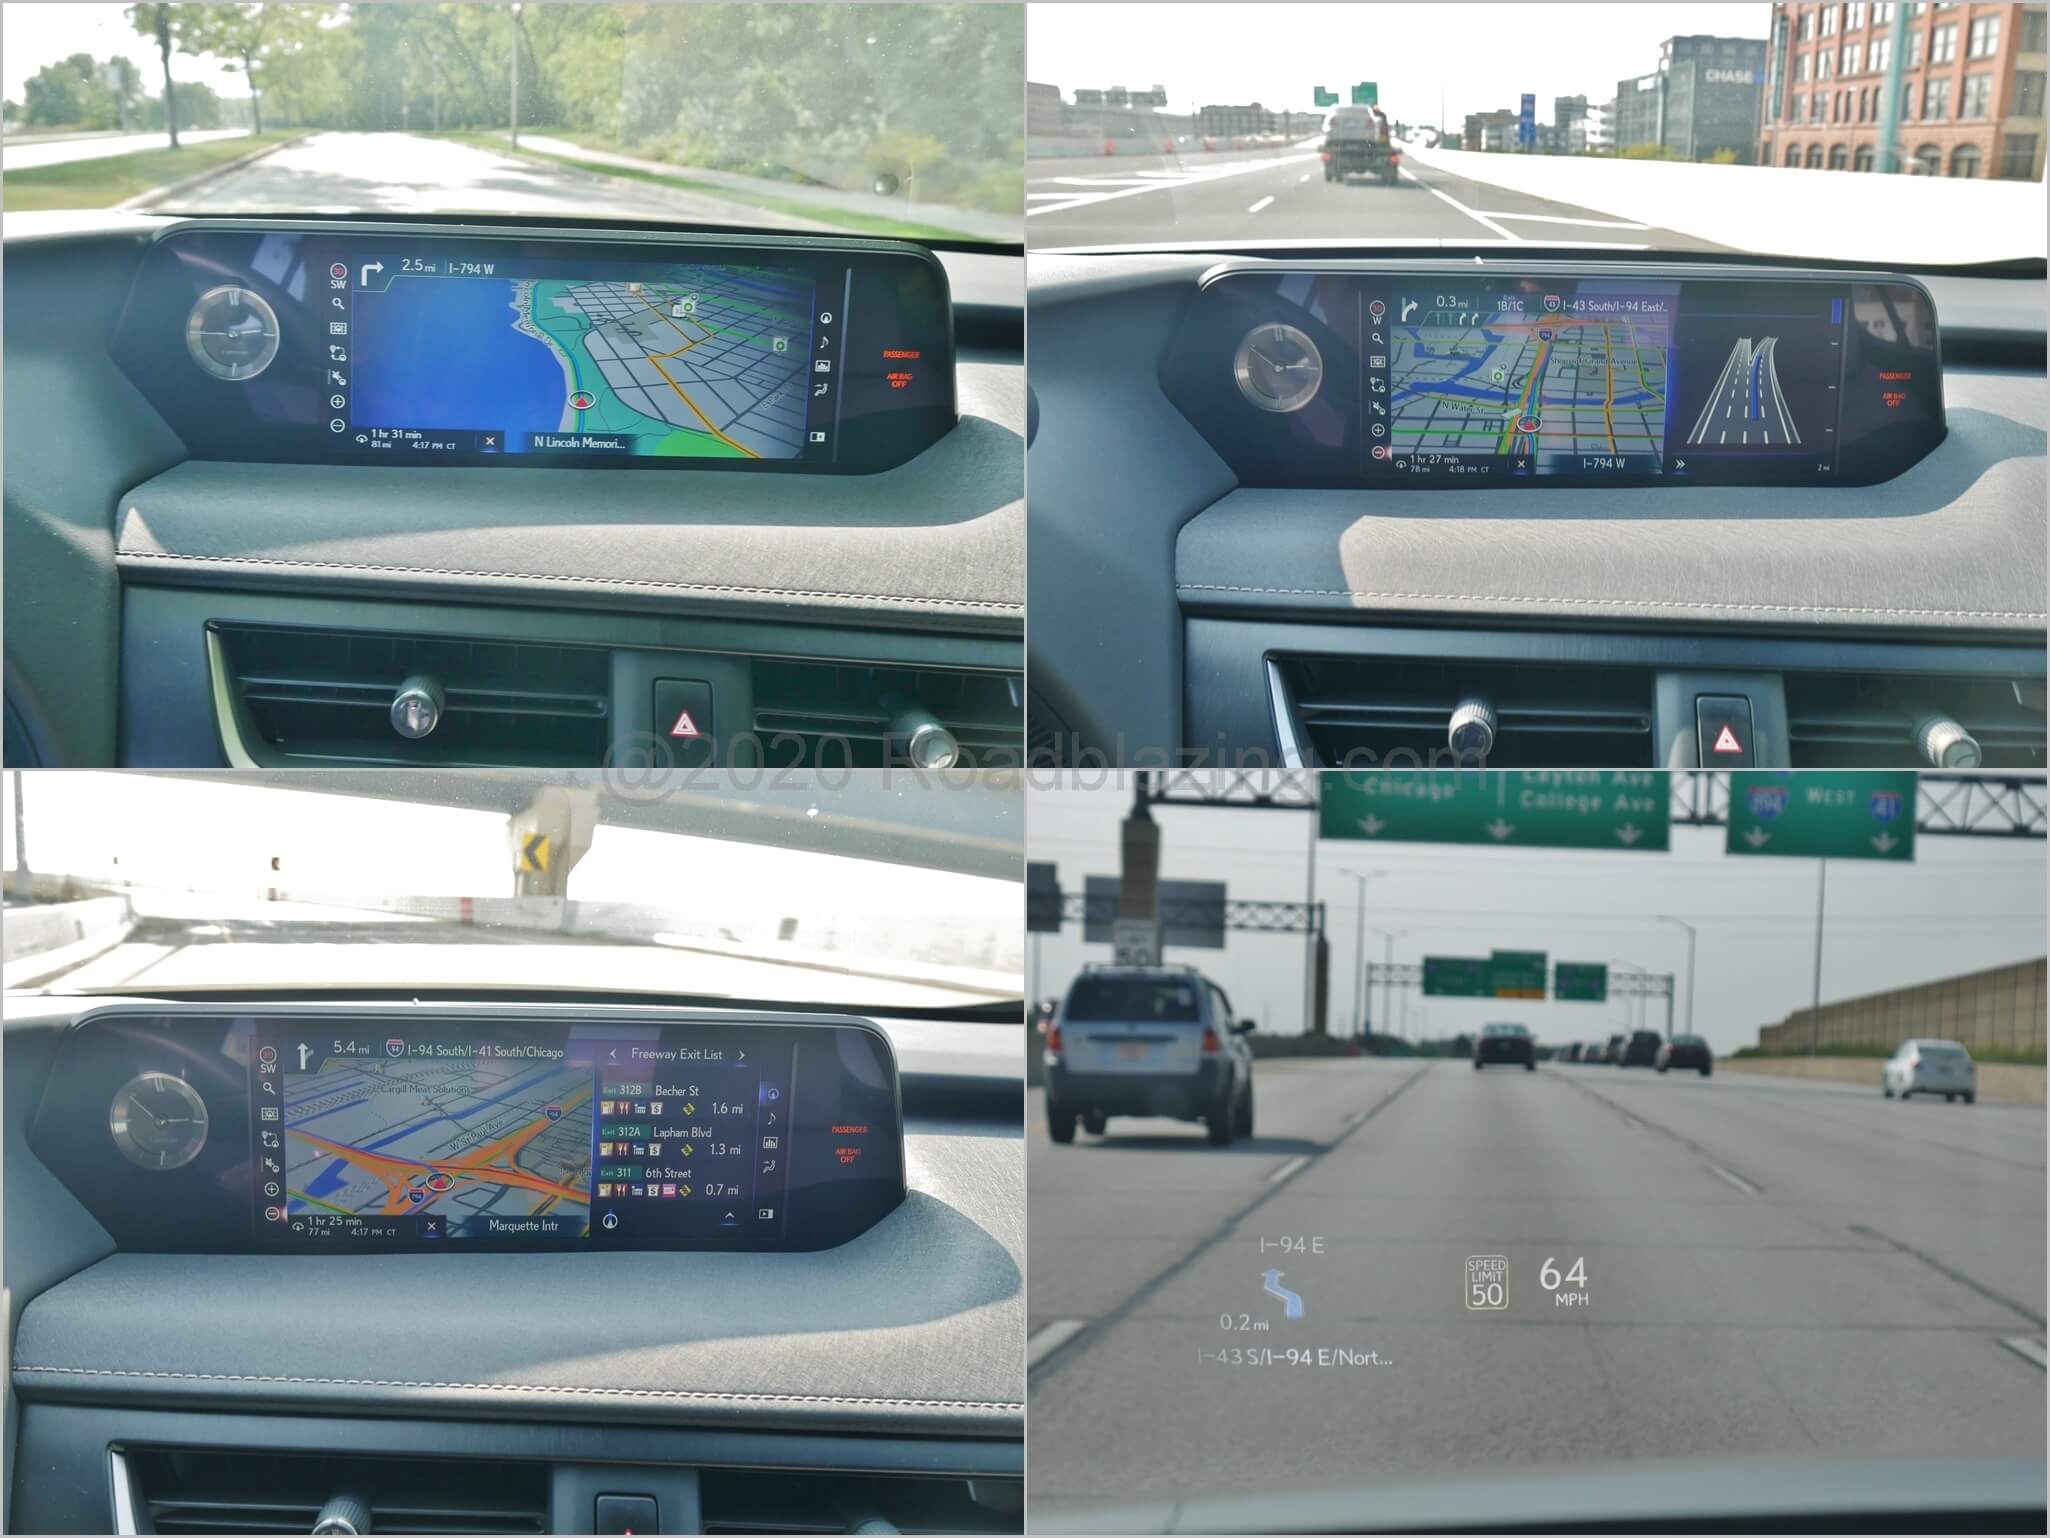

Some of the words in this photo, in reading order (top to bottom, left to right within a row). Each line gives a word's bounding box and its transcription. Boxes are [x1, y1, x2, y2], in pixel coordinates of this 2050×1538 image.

[1705, 68, 1754, 84] CHASE
[402, 258, 424, 272] 2.5
[424, 263, 437, 273] mi
[449, 263, 481, 274] I-794
[483, 263, 495, 275] W
[330, 280, 347, 289] SW
[1436, 295, 1457, 308] 0.3
[1458, 299, 1469, 309] mi
[1497, 300, 1525, 312] 1B/1C
[1563, 299, 1586, 311] I-43
[1373, 317, 1382, 325] W
[372, 429, 377, 438] 1
[379, 429, 389, 438] hr
[391, 429, 403, 439] 31
[405, 430, 422, 439] min
[371, 440, 381, 448] 81
[412, 441, 430, 449] 4:17
[534, 436, 544, 447] N
[546, 436, 580, 448] Lincoln
[1410, 454, 1415, 464] 1
[1418, 455, 1426, 464] hr
[1429, 454, 1442, 464] 27
[1444, 456, 1460, 464] min
[1583, 457, 1613, 469] I-794
[1615, 457, 1626, 469] W
[1449, 465, 1465, 473] 4:18
[1520, 789, 1602, 815] College
[1614, 794, 1656, 812] Ave
[334, 1040, 356, 1053] 5.4
[358, 1044, 370, 1055] mi
[408, 1044, 433, 1056] I-94
[436, 1044, 491, 1057] South/I-41
[495, 1045, 564, 1060] South/Chicago
[631, 1047, 677, 1061] Freeway
[680, 1048, 701, 1060] Exit
[704, 1049, 723, 1060] List
[260, 1064, 277, 1073] SW
[619, 1085, 642, 1095] 312B
[655, 1085, 686, 1096] Becher
[689, 1085, 699, 1096] St
[711, 1102, 728, 1114] 1.6
[732, 1103, 744, 1114] mi
[618, 1126, 641, 1137] 312A
[653, 1126, 689, 1140] Lapham
[691, 1126, 712, 1138] Blvd
[710, 1143, 726, 1155] 1.3
[729, 1144, 741, 1155] mi
[617, 1167, 631, 1178] 311
[645, 1168, 662, 1179] 6th
[664, 1168, 692, 1179] Street
[705, 1183, 724, 1196] 0.7
[727, 1184, 739, 1196] mi
[308, 1216, 313, 1226] 1
[316, 1216, 326, 1226] hr
[329, 1216, 343, 1226] 25
[345, 1217, 362, 1226] min
[489, 1219, 539, 1233] Marquette
[542, 1220, 559, 1232] Intr
[308, 1227, 319, 1236] 77
[321, 1228, 331, 1236] mi
[351, 1227, 368, 1236] 4:17
[386, 1228, 396, 1236] CT
[1260, 1236, 1306, 1254] I-94
[1312, 1236, 1325, 1254] E
[1468, 1260, 1506, 1271] SPEED
[1472, 1271, 1504, 1283] LIMIT
[1540, 1256, 1588, 1290] 64
[1472, 1283, 1503, 1306] 50
[1555, 1292, 1589, 1307] MPH
[1219, 1313, 1250, 1331] 0.2
[1253, 1319, 1270, 1331] mi
[1247, 1347, 1312, 1366] S/I-94
